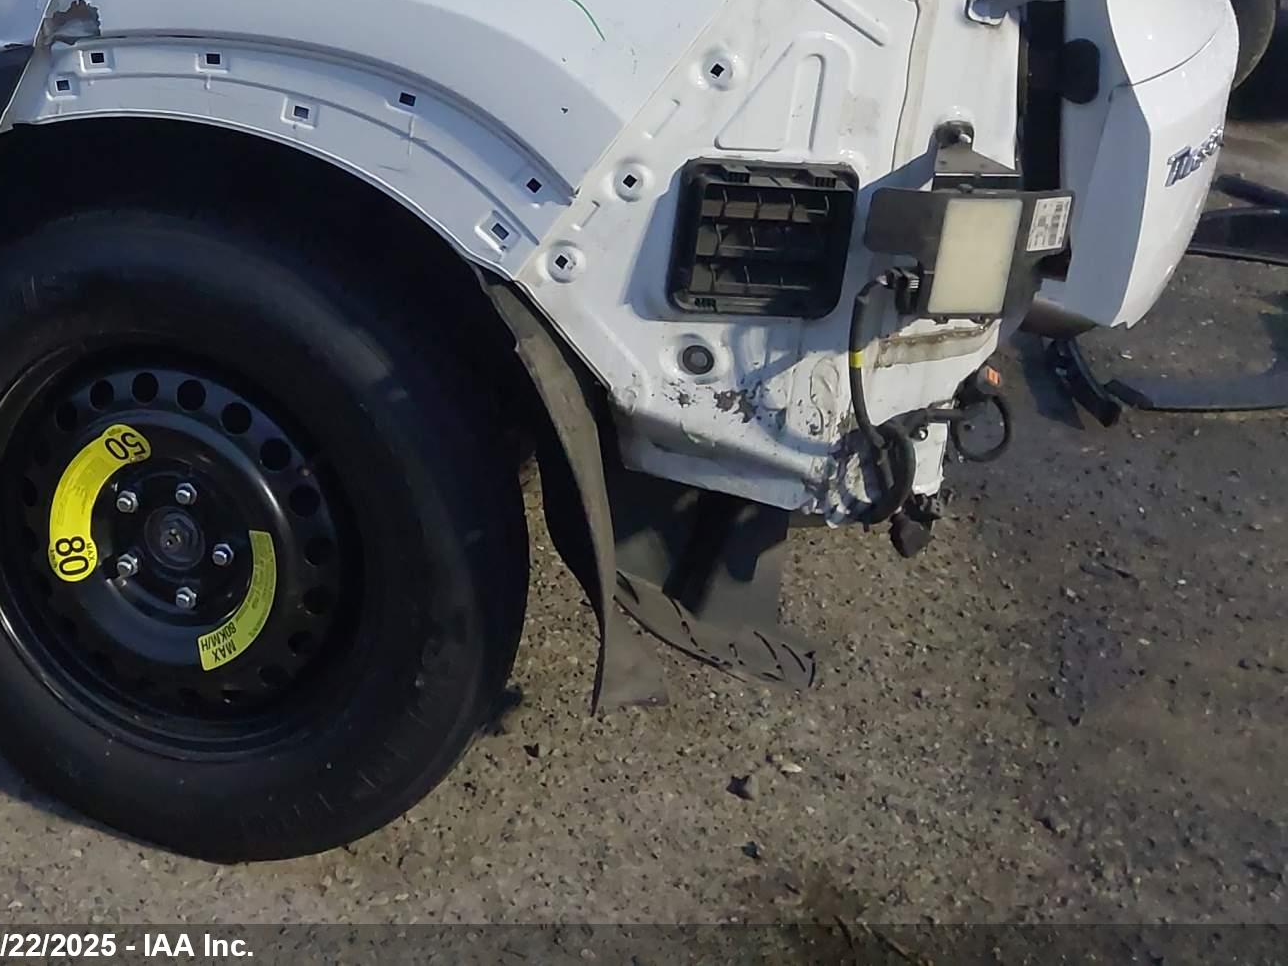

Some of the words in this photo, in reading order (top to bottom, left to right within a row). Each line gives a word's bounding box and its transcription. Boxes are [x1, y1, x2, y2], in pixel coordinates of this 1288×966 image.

[105, 433, 146, 460] 50
[56, 536, 88, 575] 80
[212, 639, 237, 663] MAX
